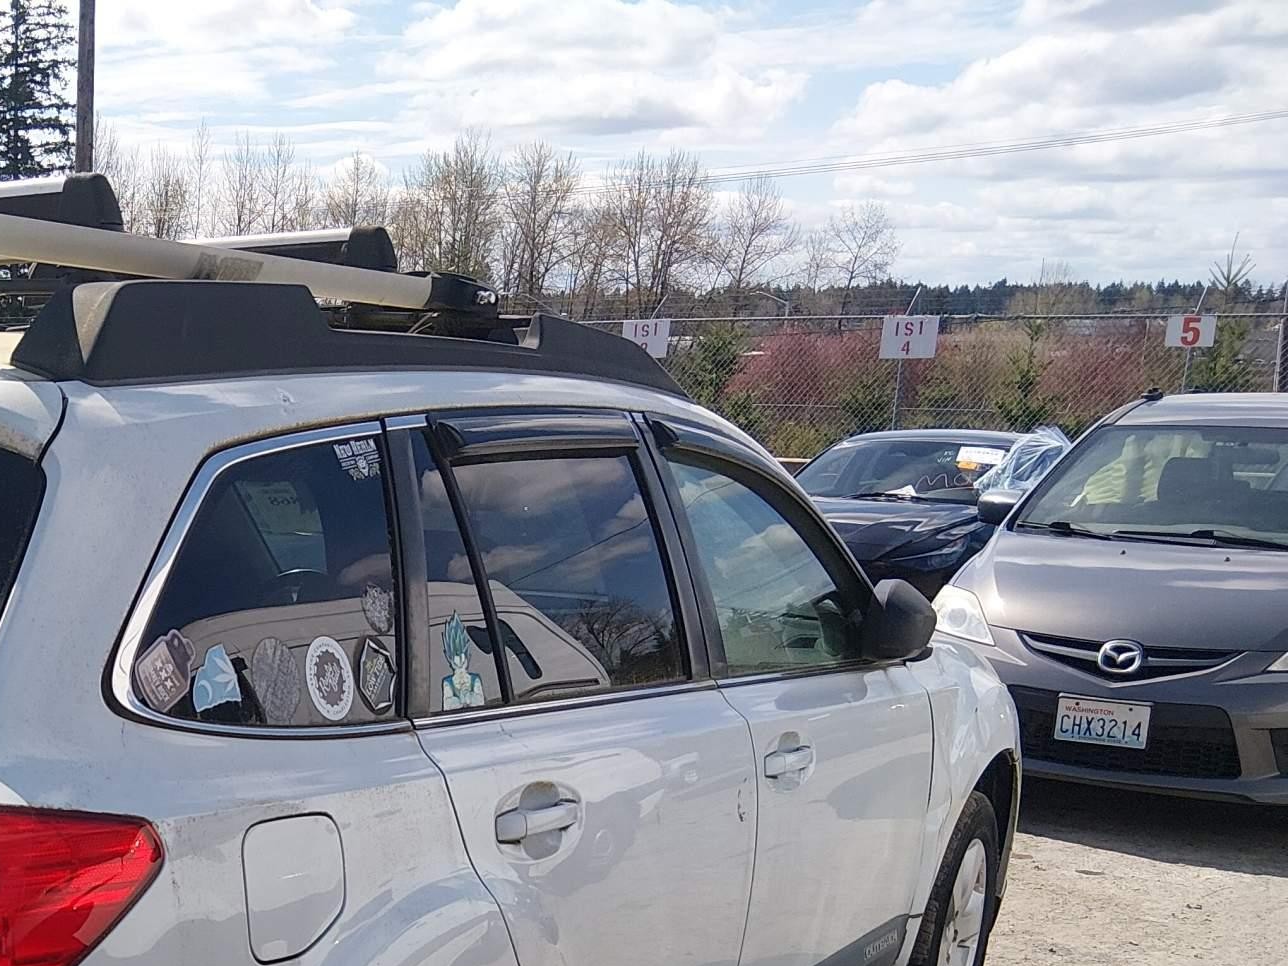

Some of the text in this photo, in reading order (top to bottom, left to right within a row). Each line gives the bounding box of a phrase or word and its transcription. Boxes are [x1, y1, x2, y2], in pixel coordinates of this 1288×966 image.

[1180, 316, 1202, 346] 5
[901, 340, 910, 355] 4
[1065, 705, 1114, 716] WASHINGTON
[1059, 714, 1142, 742] CHX3214
